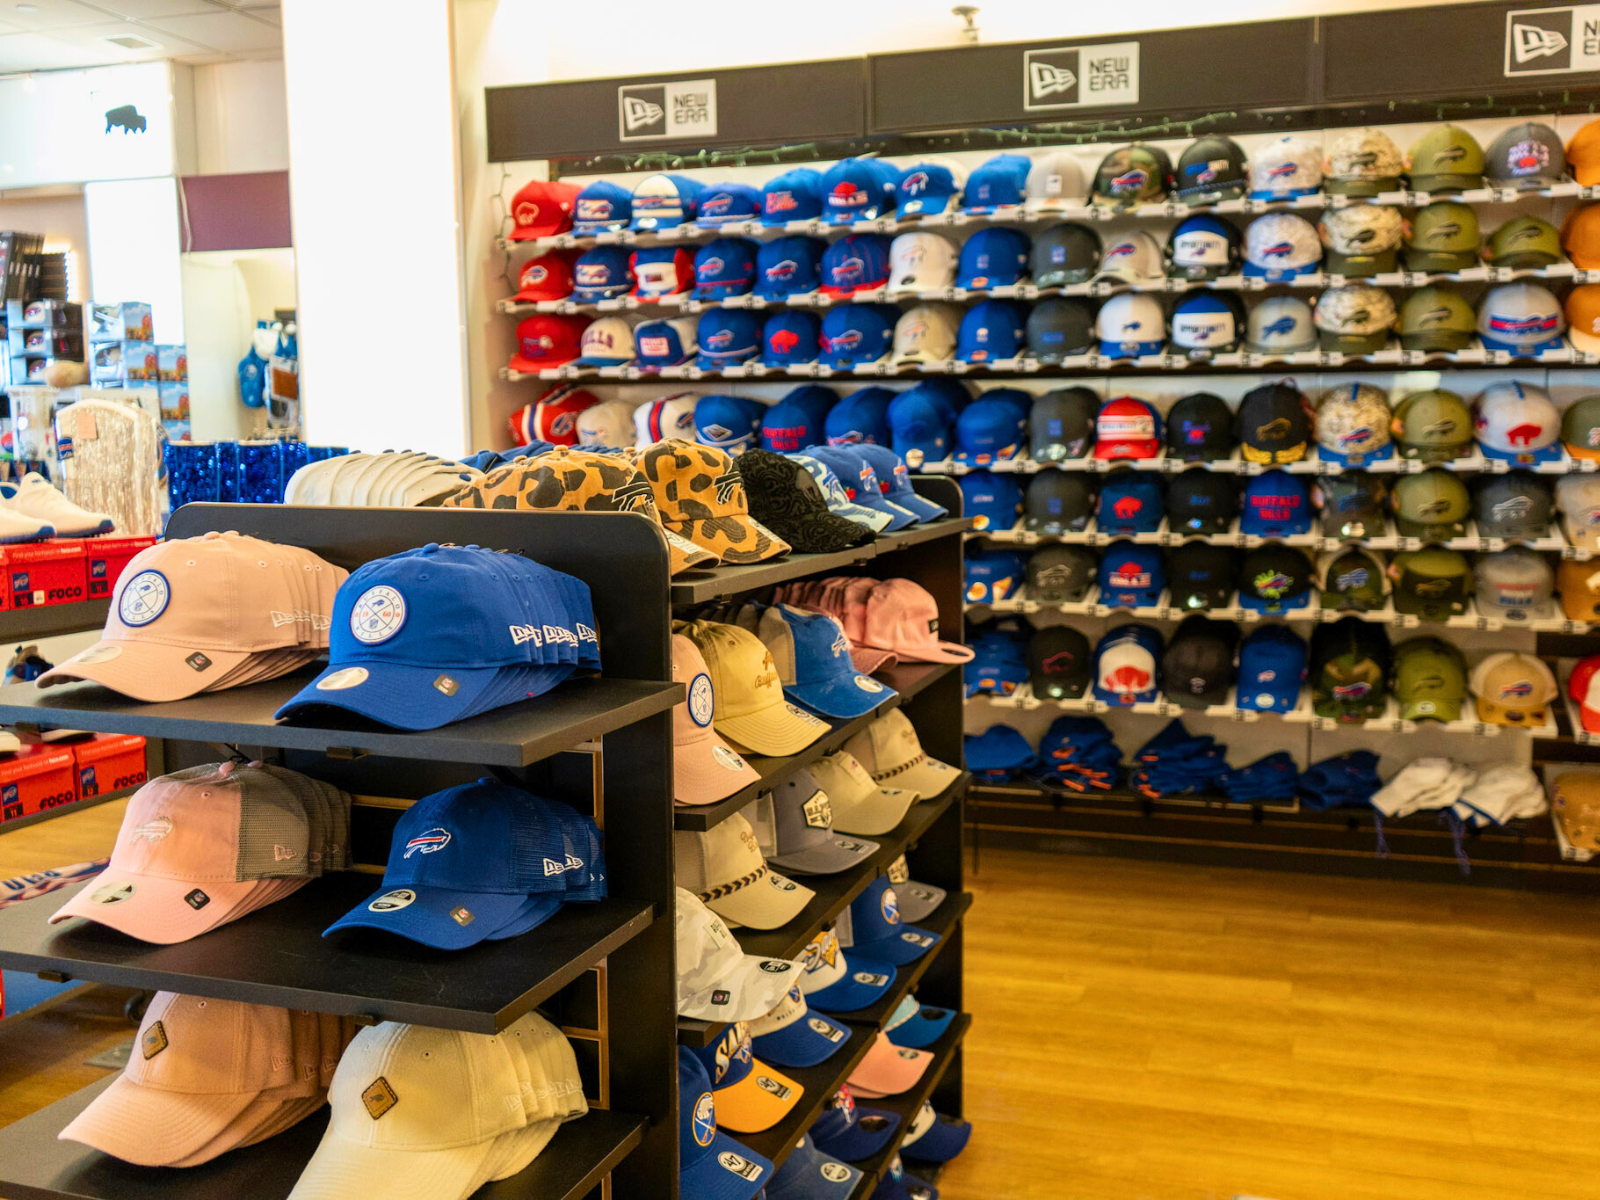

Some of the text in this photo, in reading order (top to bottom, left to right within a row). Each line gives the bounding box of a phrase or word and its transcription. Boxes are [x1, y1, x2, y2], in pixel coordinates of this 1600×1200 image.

[1089, 57, 1129, 73] NEW
[1089, 74, 1129, 91] ERA
[674, 92, 708, 108] NEW
[675, 108, 708, 125] ERA
[48, 587, 82, 600] FOCO
[113, 771, 144, 789] FOCO
[40, 791, 73, 809] FOCO
